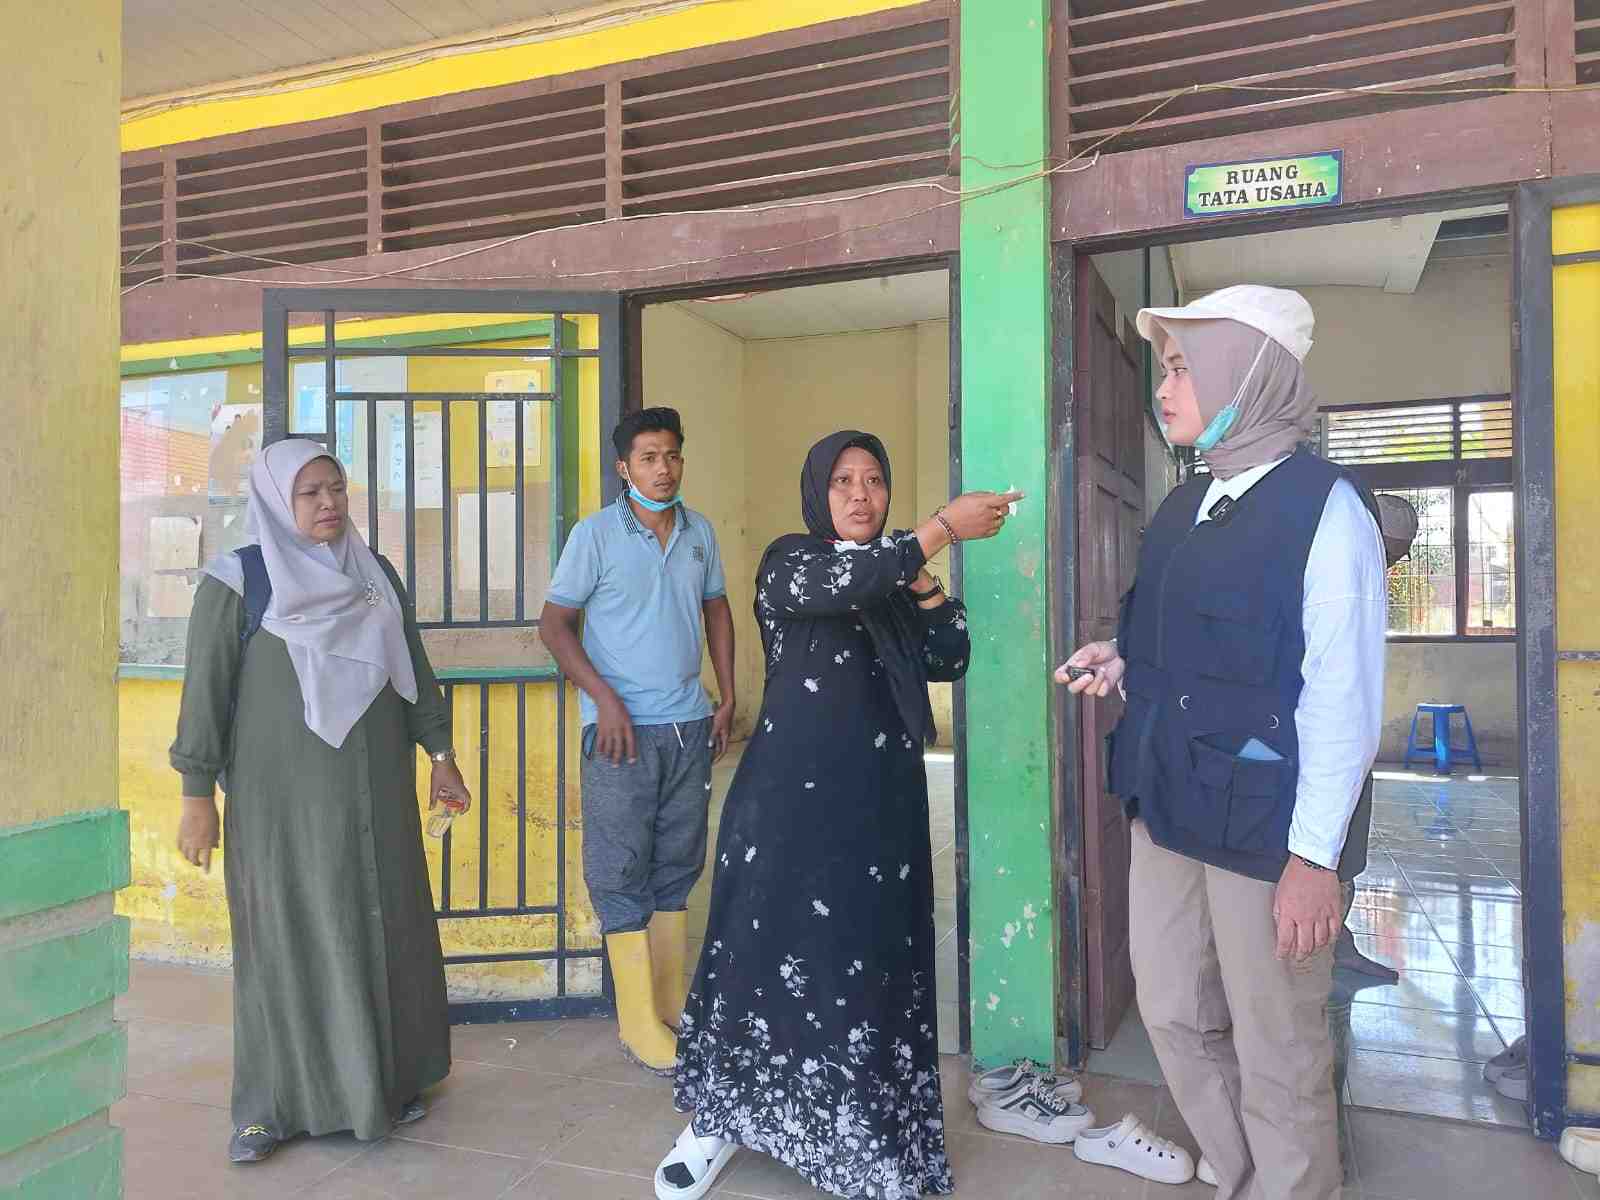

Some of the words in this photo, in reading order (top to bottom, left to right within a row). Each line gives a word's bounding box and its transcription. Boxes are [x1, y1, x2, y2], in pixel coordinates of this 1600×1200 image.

[1226, 165, 1298, 185] RUANG
[1199, 189, 1249, 207] TATA
[1255, 182, 1327, 202] USAHA
